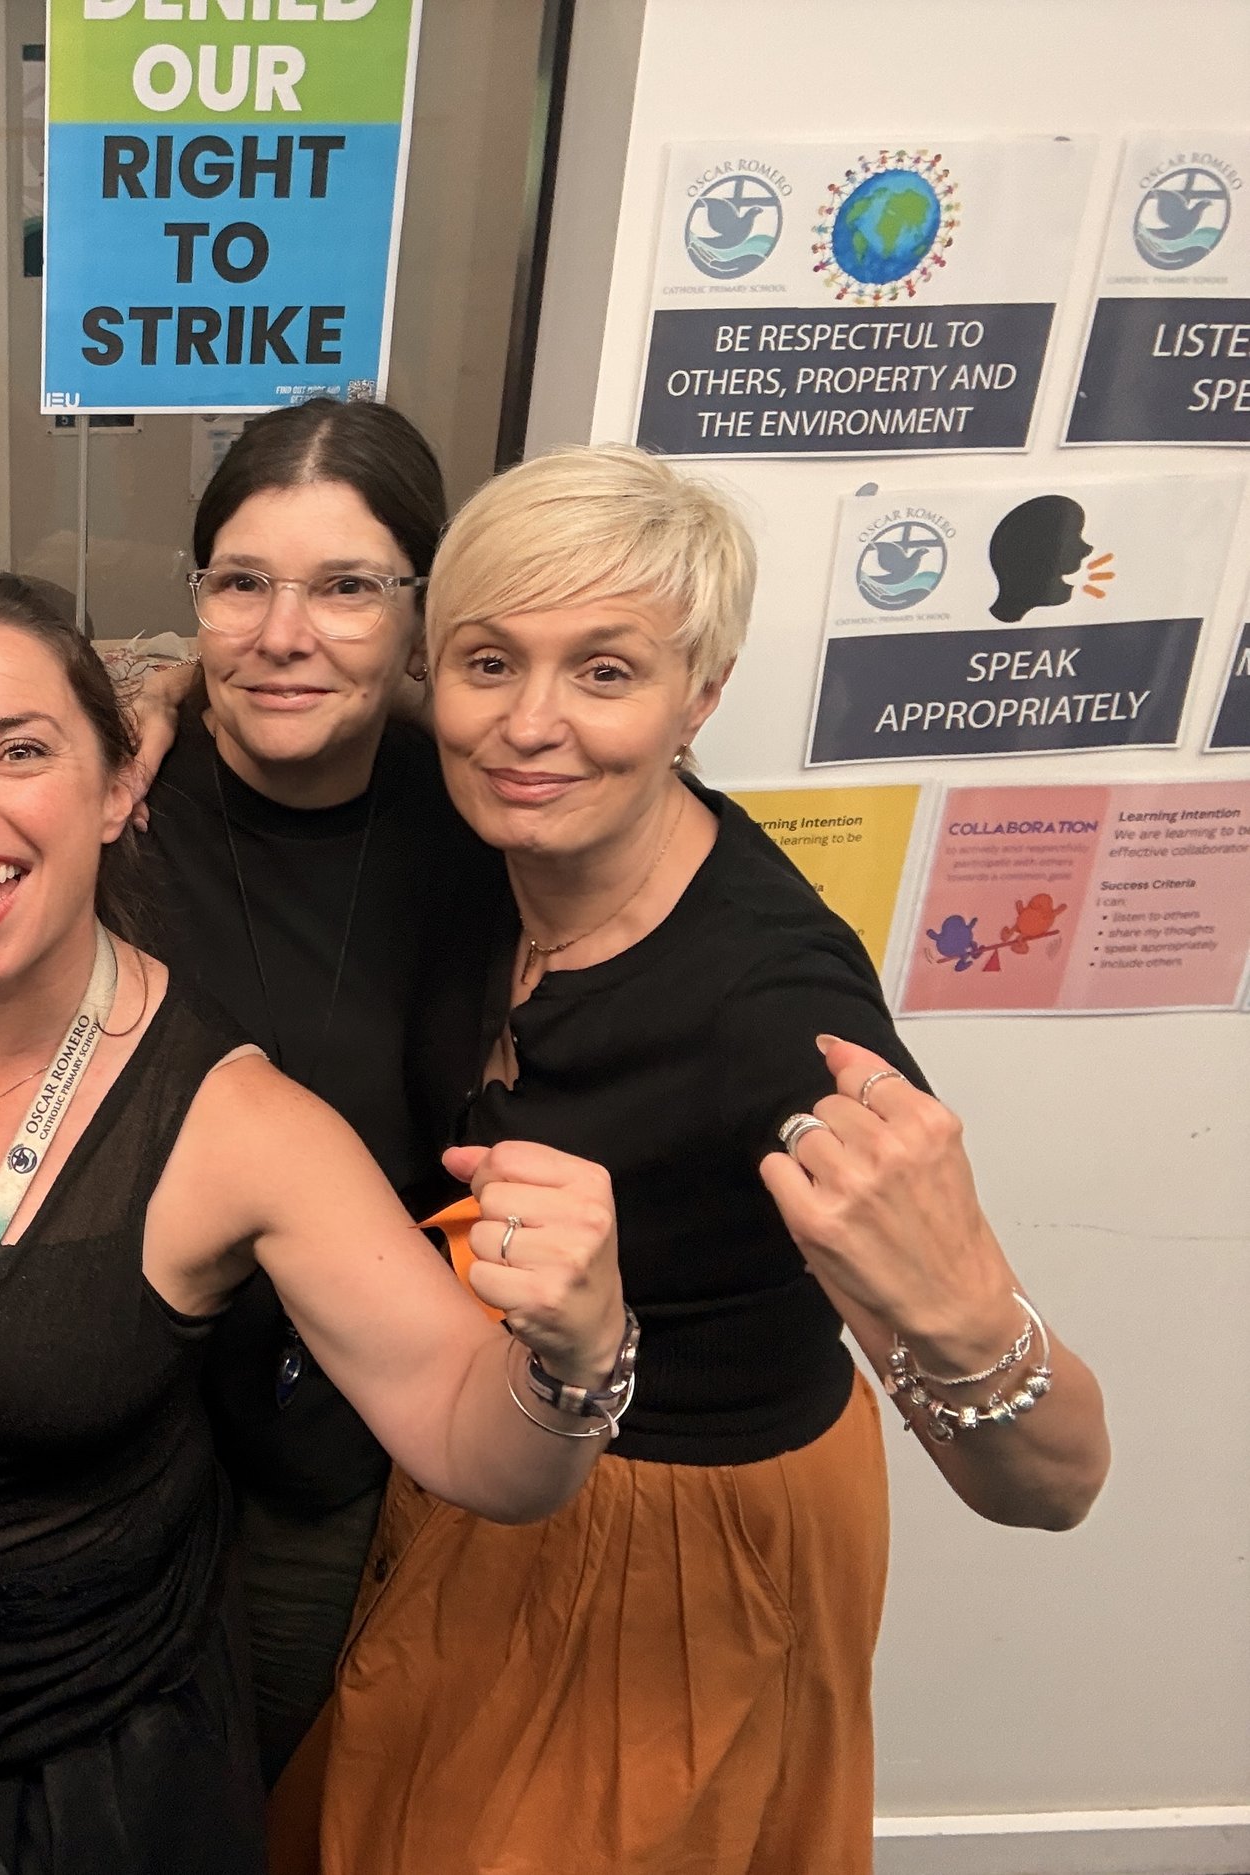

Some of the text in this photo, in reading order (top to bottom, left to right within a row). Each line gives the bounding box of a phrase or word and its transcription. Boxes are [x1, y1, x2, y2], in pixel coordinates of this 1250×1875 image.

[132, 44, 306, 112] OUR
[102, 135, 346, 199] RIGHT
[687, 159, 793, 198] OSCAR ROMERO
[164, 222, 270, 284] TO
[81, 306, 345, 366] STRIKE
[715, 320, 985, 353] BE RESPECTFUL TO
[1152, 324, 1250, 356] LISTE
[667, 363, 1017, 398] OTHERS, PROPERTY AND
[46, 392, 80, 408] IEU
[697, 406, 973, 438] THE ENVIRONMENT
[858, 508, 956, 543] OSCAR ROMERO
[966, 648, 1082, 683] SPEAK
[875, 690, 1152, 734] APPROPRIATELY
[801, 815, 863, 828] Intention
[948, 821, 1099, 835] COLLABORATION
[1118, 808, 1241, 824] Learning Intention
[780, 836, 829, 846] learning
[832, 834, 844, 844] to
[847, 833, 862, 843] be
[1109, 846, 1169, 858] effective
[1114, 830, 1135, 840] We
[1100, 879, 1196, 890] Success Criteria
[25, 1014, 90, 1134] OSCAR ROMERO
[39, 1093, 66, 1140] CATHOLIC
[61, 1055, 85, 1095] PRIMARY
